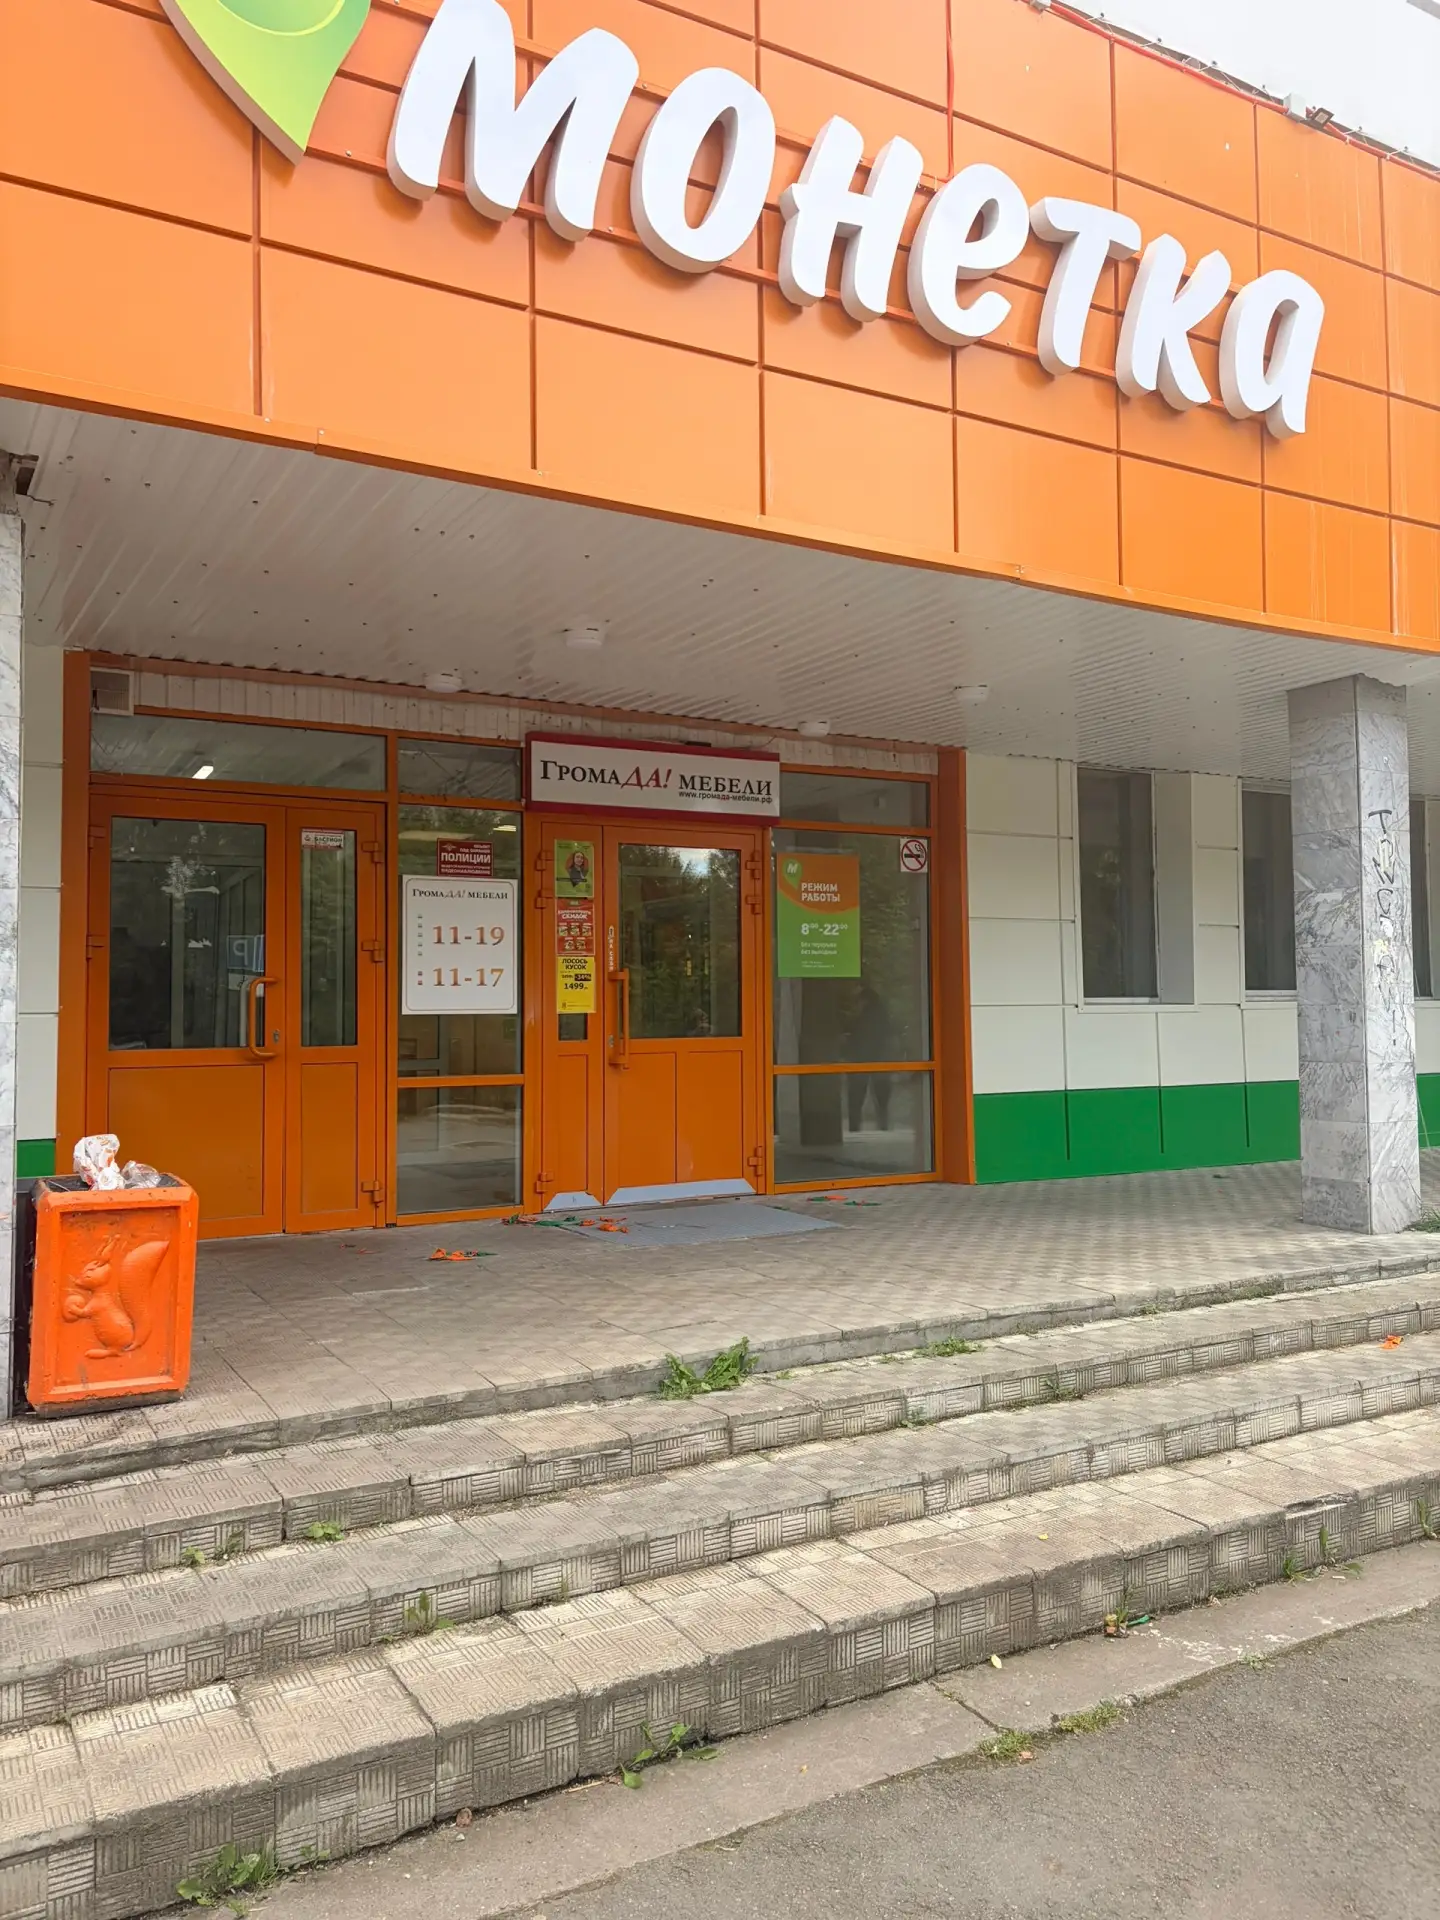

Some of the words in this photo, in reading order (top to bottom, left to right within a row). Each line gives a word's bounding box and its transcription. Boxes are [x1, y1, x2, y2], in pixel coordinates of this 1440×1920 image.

[678, 774, 772, 796] МЕБЕЛИ
[678, 791, 773, 804] www.громада-мебели.рф
[441, 853, 490, 864] ПОЛИЦИИ
[801, 882, 838, 892] РЕЖИМ
[467, 891, 508, 900] МЕБЕЛИ
[801, 893, 841, 902] РАБОТЫ
[433, 925, 505, 946] 11-19
[433, 967, 505, 988] 11-17
